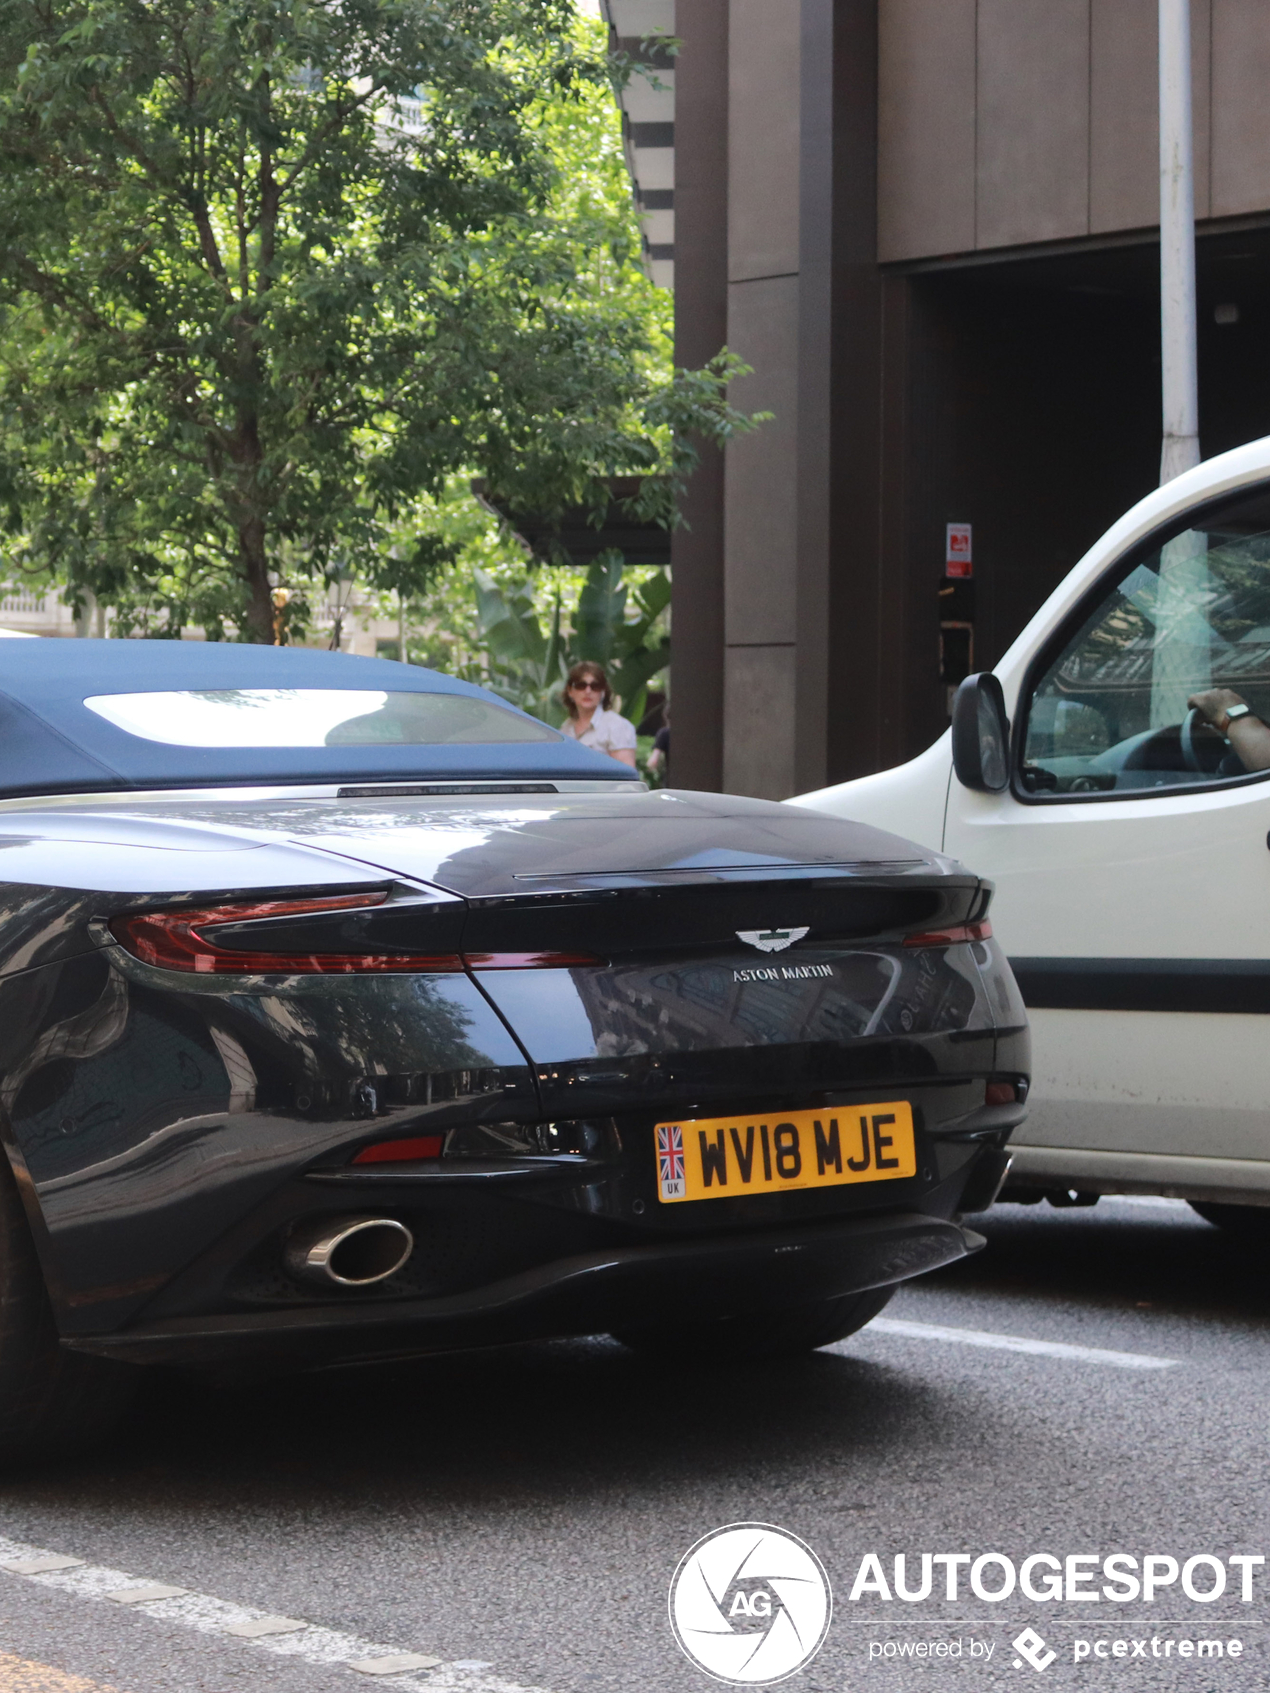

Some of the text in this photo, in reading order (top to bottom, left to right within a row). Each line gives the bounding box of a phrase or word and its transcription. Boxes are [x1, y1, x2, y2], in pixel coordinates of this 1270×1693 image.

[733, 964, 833, 982] ASTON MARTIN
[698, 1114, 899, 1187] WV18 MJE
[667, 1182, 680, 1194] UK
